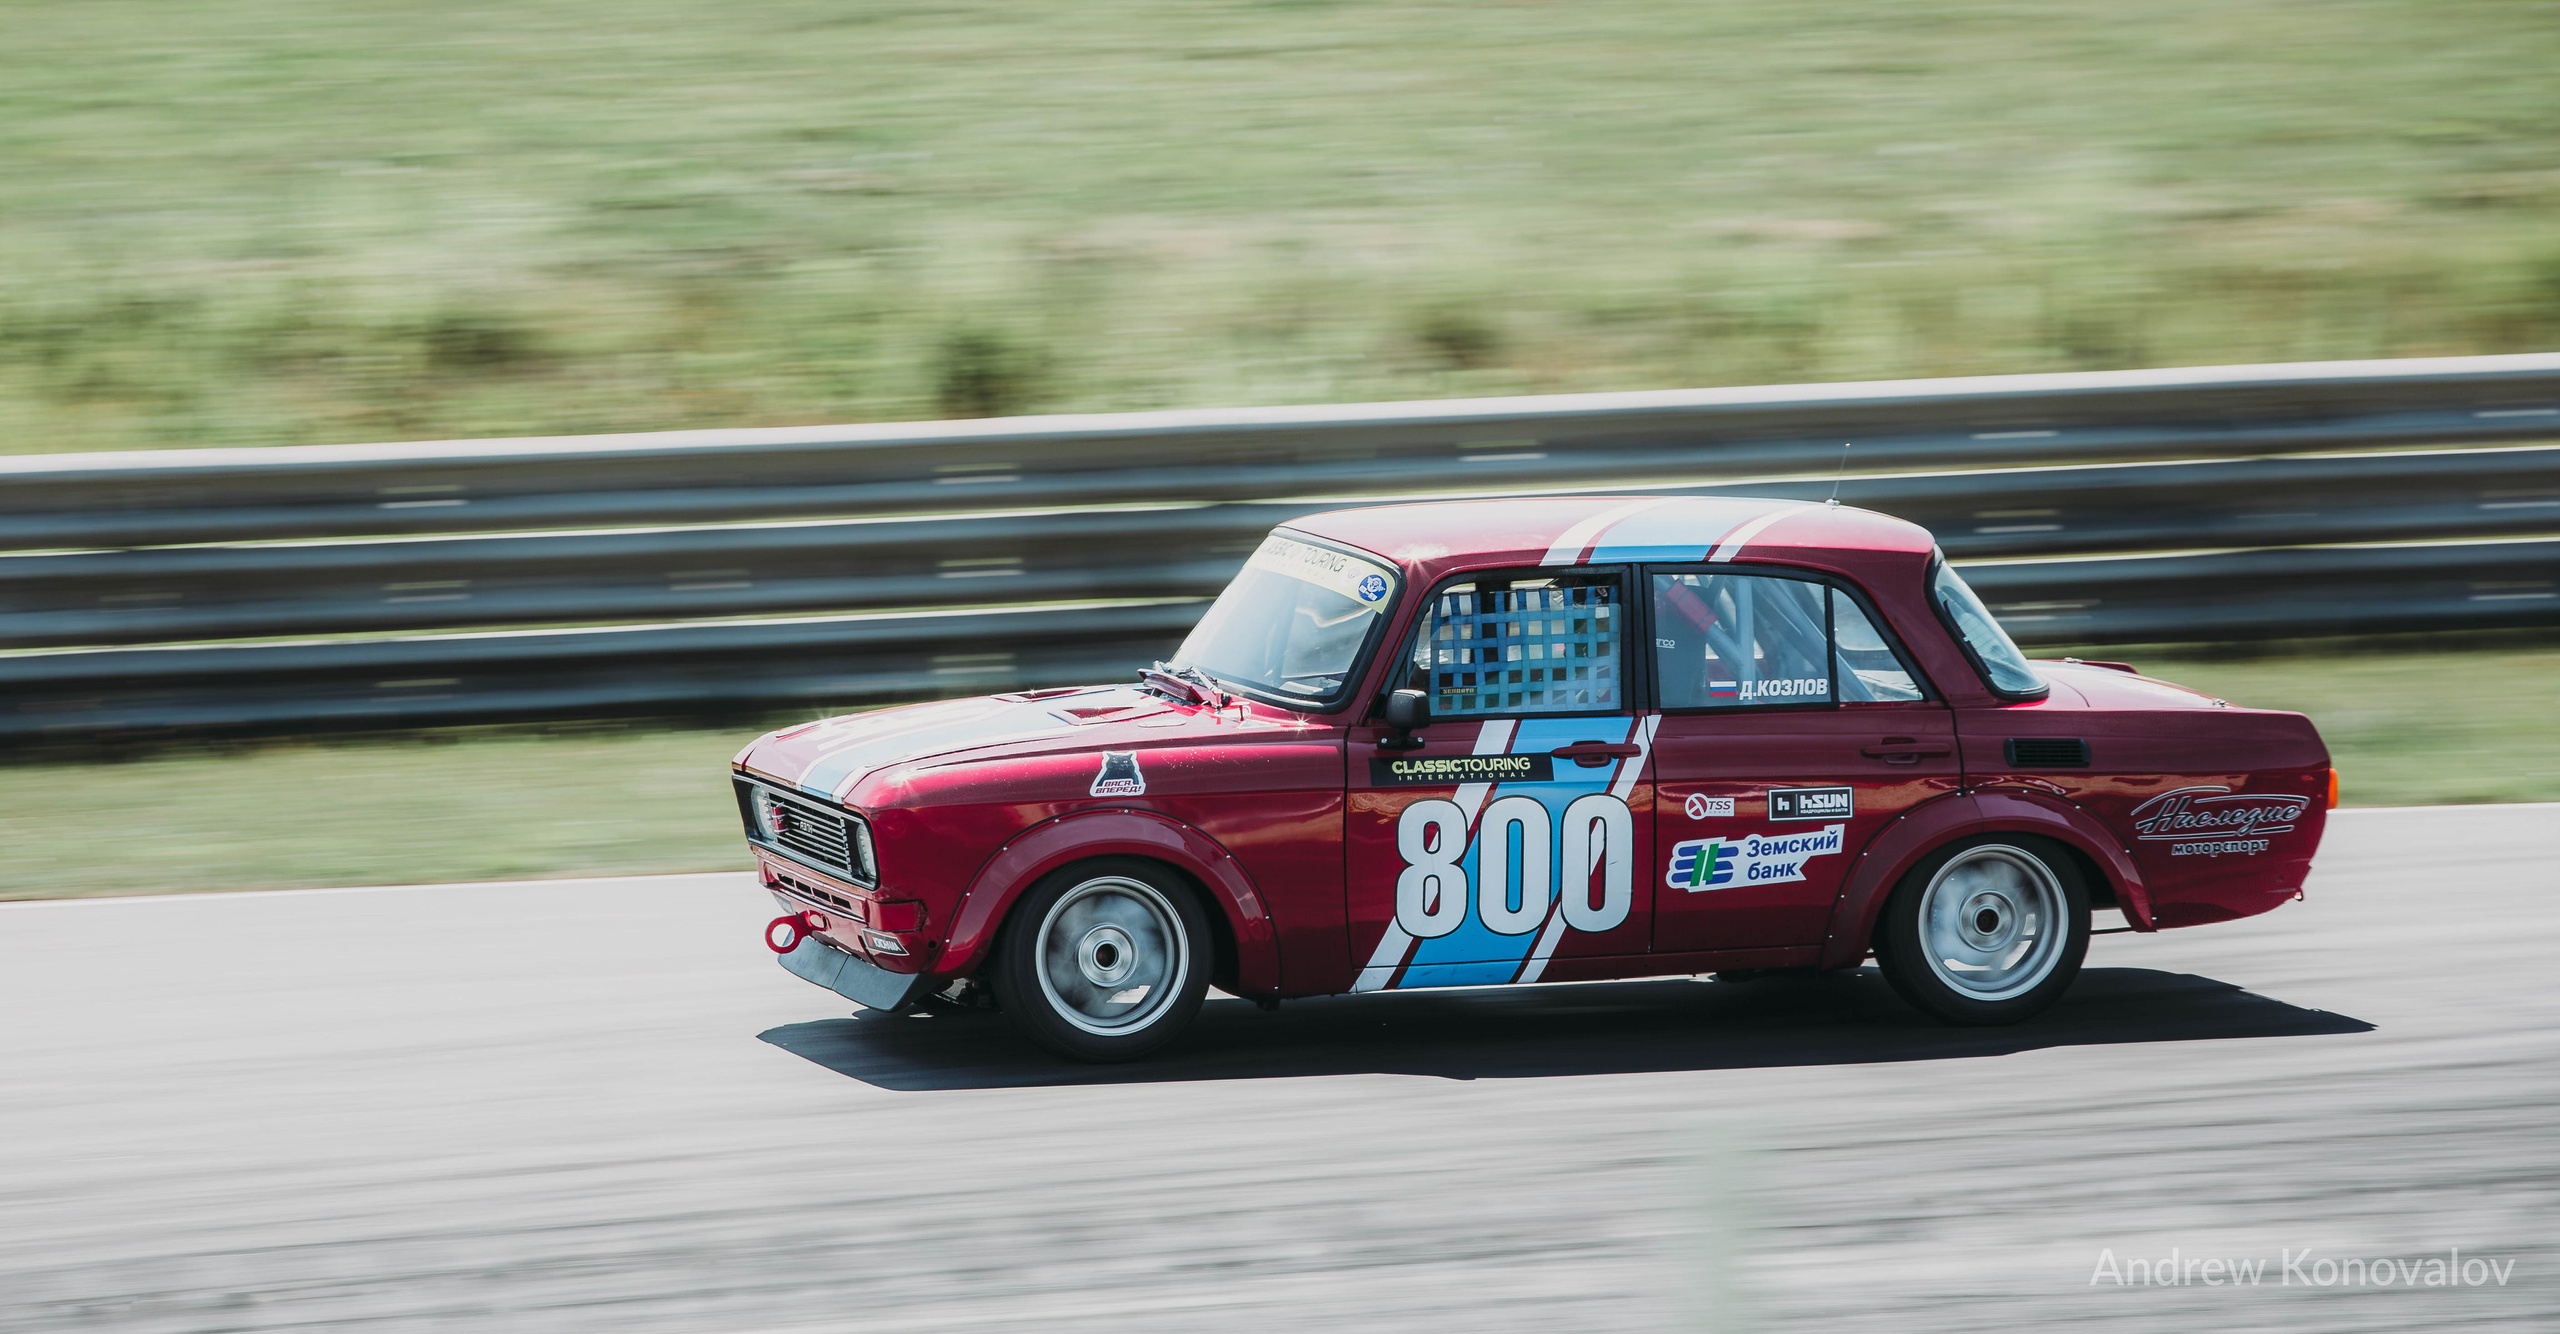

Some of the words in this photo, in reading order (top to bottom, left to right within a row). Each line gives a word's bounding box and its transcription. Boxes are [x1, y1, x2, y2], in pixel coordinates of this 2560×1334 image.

[1301, 547, 1347, 573] TOURING
[1739, 679, 1828, 700] Д.КОЗЛОВ
[1391, 757, 1531, 774] CLASSICTOURING
[1398, 772, 1526, 781] INTERNATIONAL
[1095, 786, 1141, 794] ВПЕРЕД!
[1709, 801, 1731, 810] TSS
[2135, 796, 2303, 836] Наследие
[1747, 830, 1839, 857] Земский
[1394, 793, 1634, 939] 800
[1747, 861, 1798, 880] банк
